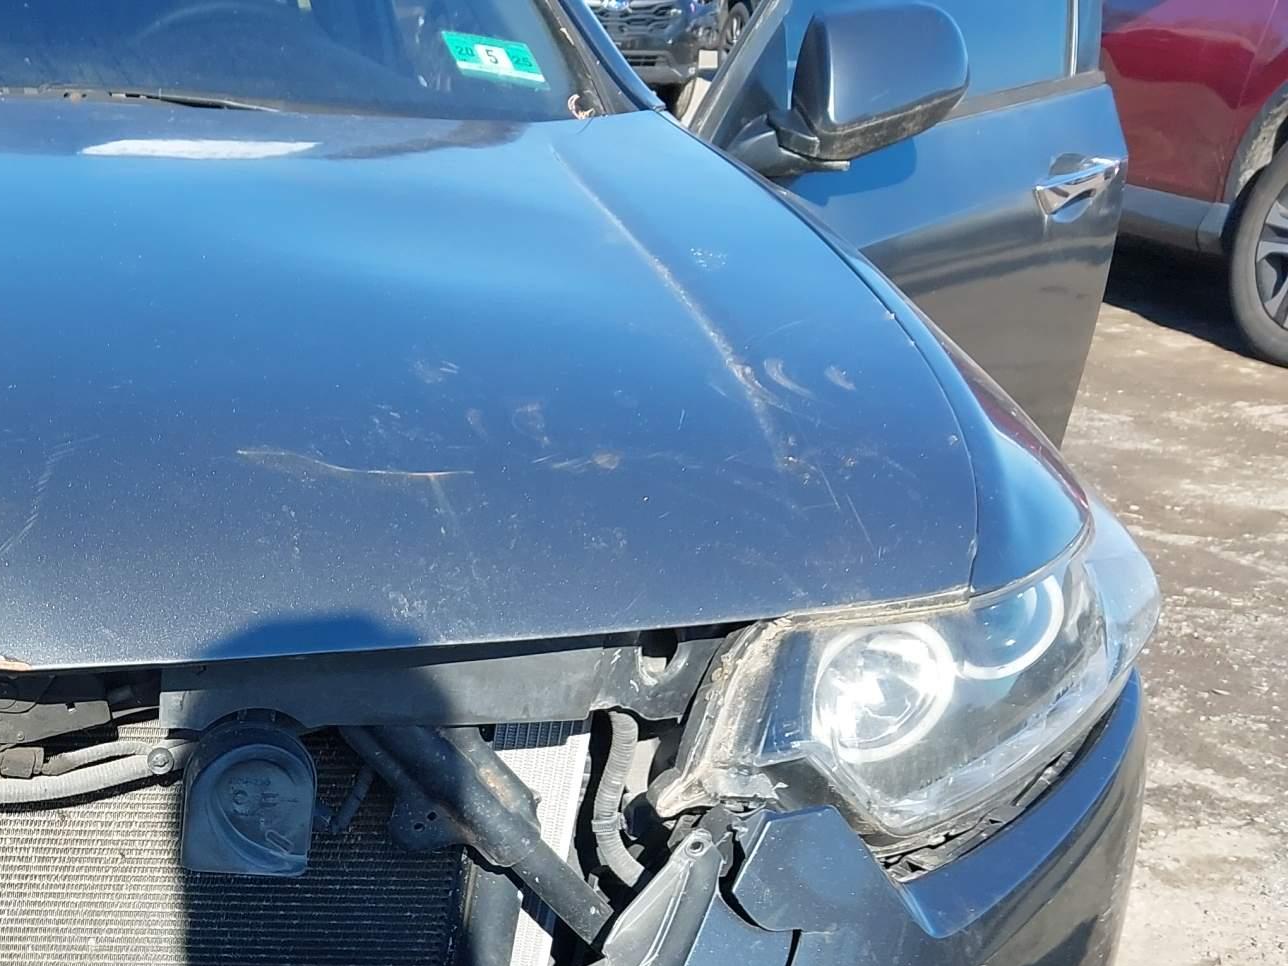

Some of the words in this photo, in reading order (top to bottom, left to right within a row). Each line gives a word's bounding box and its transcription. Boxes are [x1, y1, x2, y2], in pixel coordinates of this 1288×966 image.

[455, 45, 476, 57] 20
[485, 49, 499, 65] 5
[511, 55, 533, 67] 25
